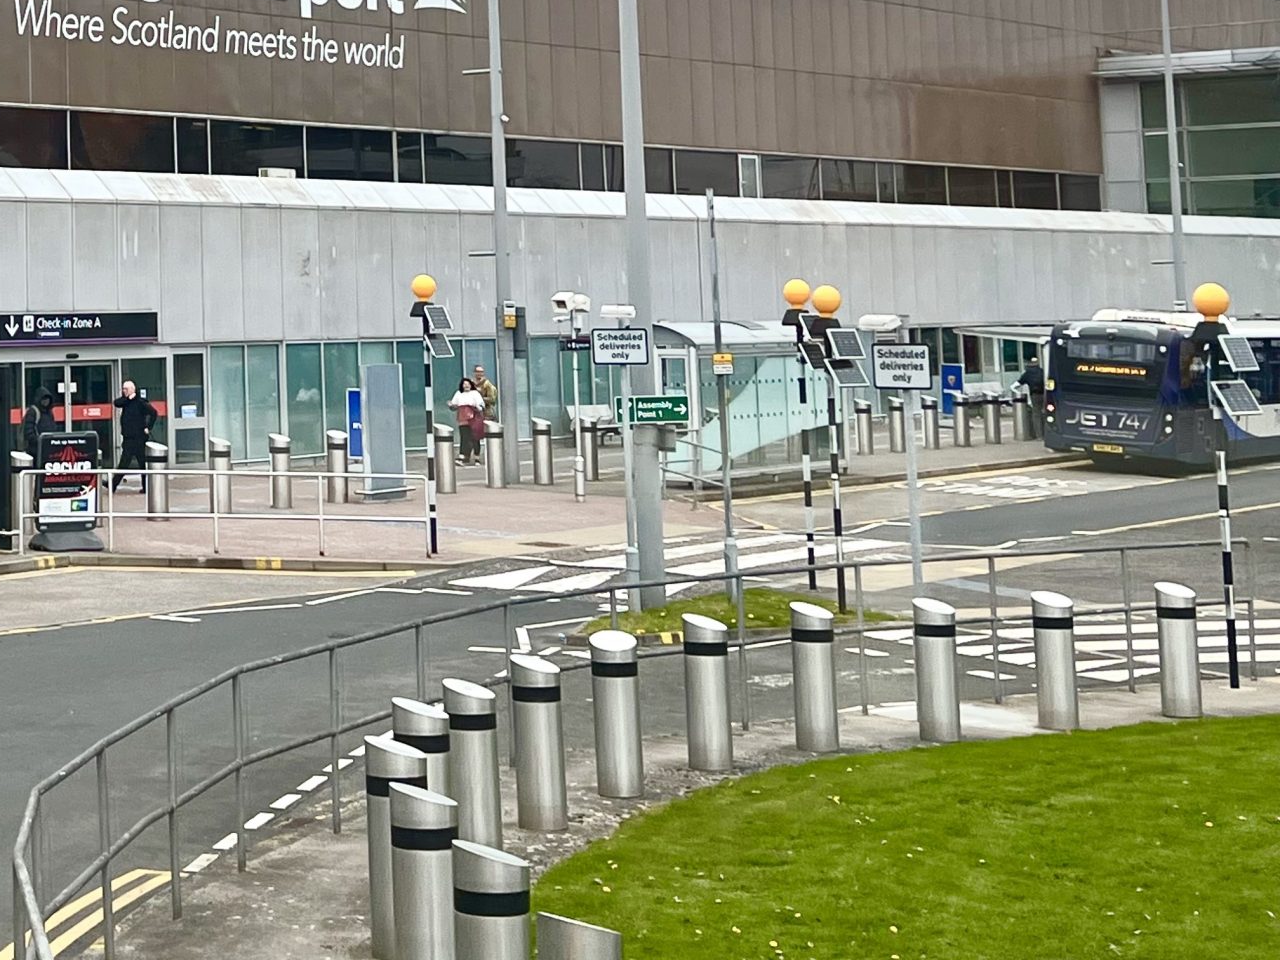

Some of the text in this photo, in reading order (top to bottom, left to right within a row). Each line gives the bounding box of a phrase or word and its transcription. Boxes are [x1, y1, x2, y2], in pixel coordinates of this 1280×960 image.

[111, 7, 219, 53] Scotland
[225, 28, 297, 60] meets
[302, 25, 338, 63] the
[344, 32, 404, 69] world
[37, 316, 102, 329] Check-in Zone A
[597, 333, 643, 341] Scheduled
[600, 342, 641, 350] deliveries
[611, 351, 630, 360] only
[877, 349, 925, 359] Scheduled
[880, 361, 924, 371] deliveries
[892, 373, 912, 384] only
[638, 401, 673, 409] Assembly
[1066, 409, 1152, 431] JET 747
[45, 461, 91, 475] secure
